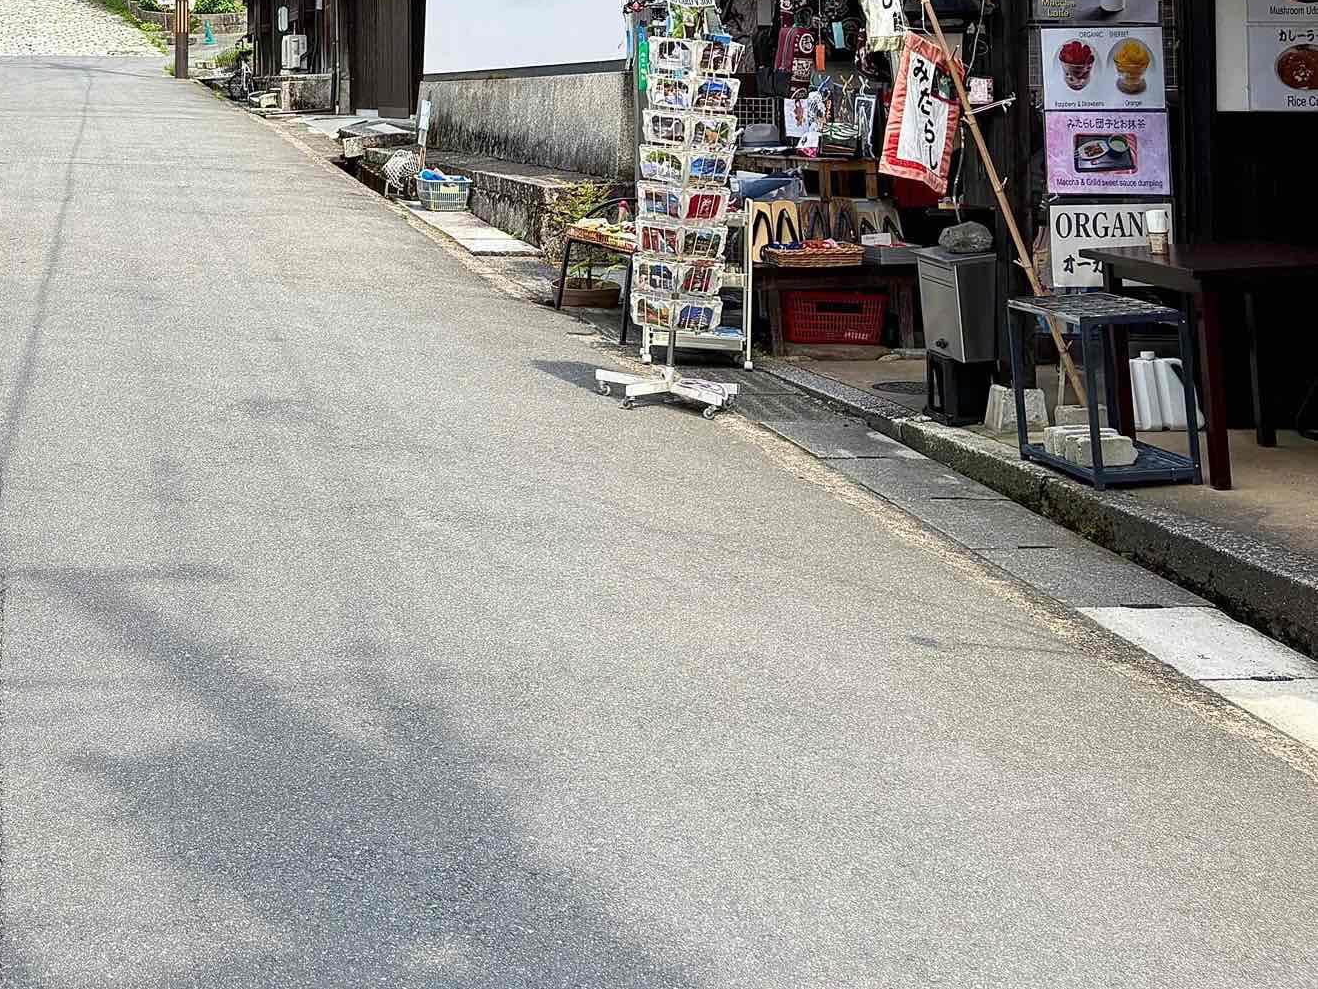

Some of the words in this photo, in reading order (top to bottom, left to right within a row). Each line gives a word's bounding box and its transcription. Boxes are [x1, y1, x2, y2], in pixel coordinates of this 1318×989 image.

[1269, 5, 1305, 15] Mushroom
[1278, 29, 1318, 42] カレーラ
[1287, 95, 1306, 107] Rice
[912, 58, 938, 171] みたらし
[1066, 118, 1146, 130] みたらし団子とお抹茶
[1055, 211, 1169, 239] ORGAN
